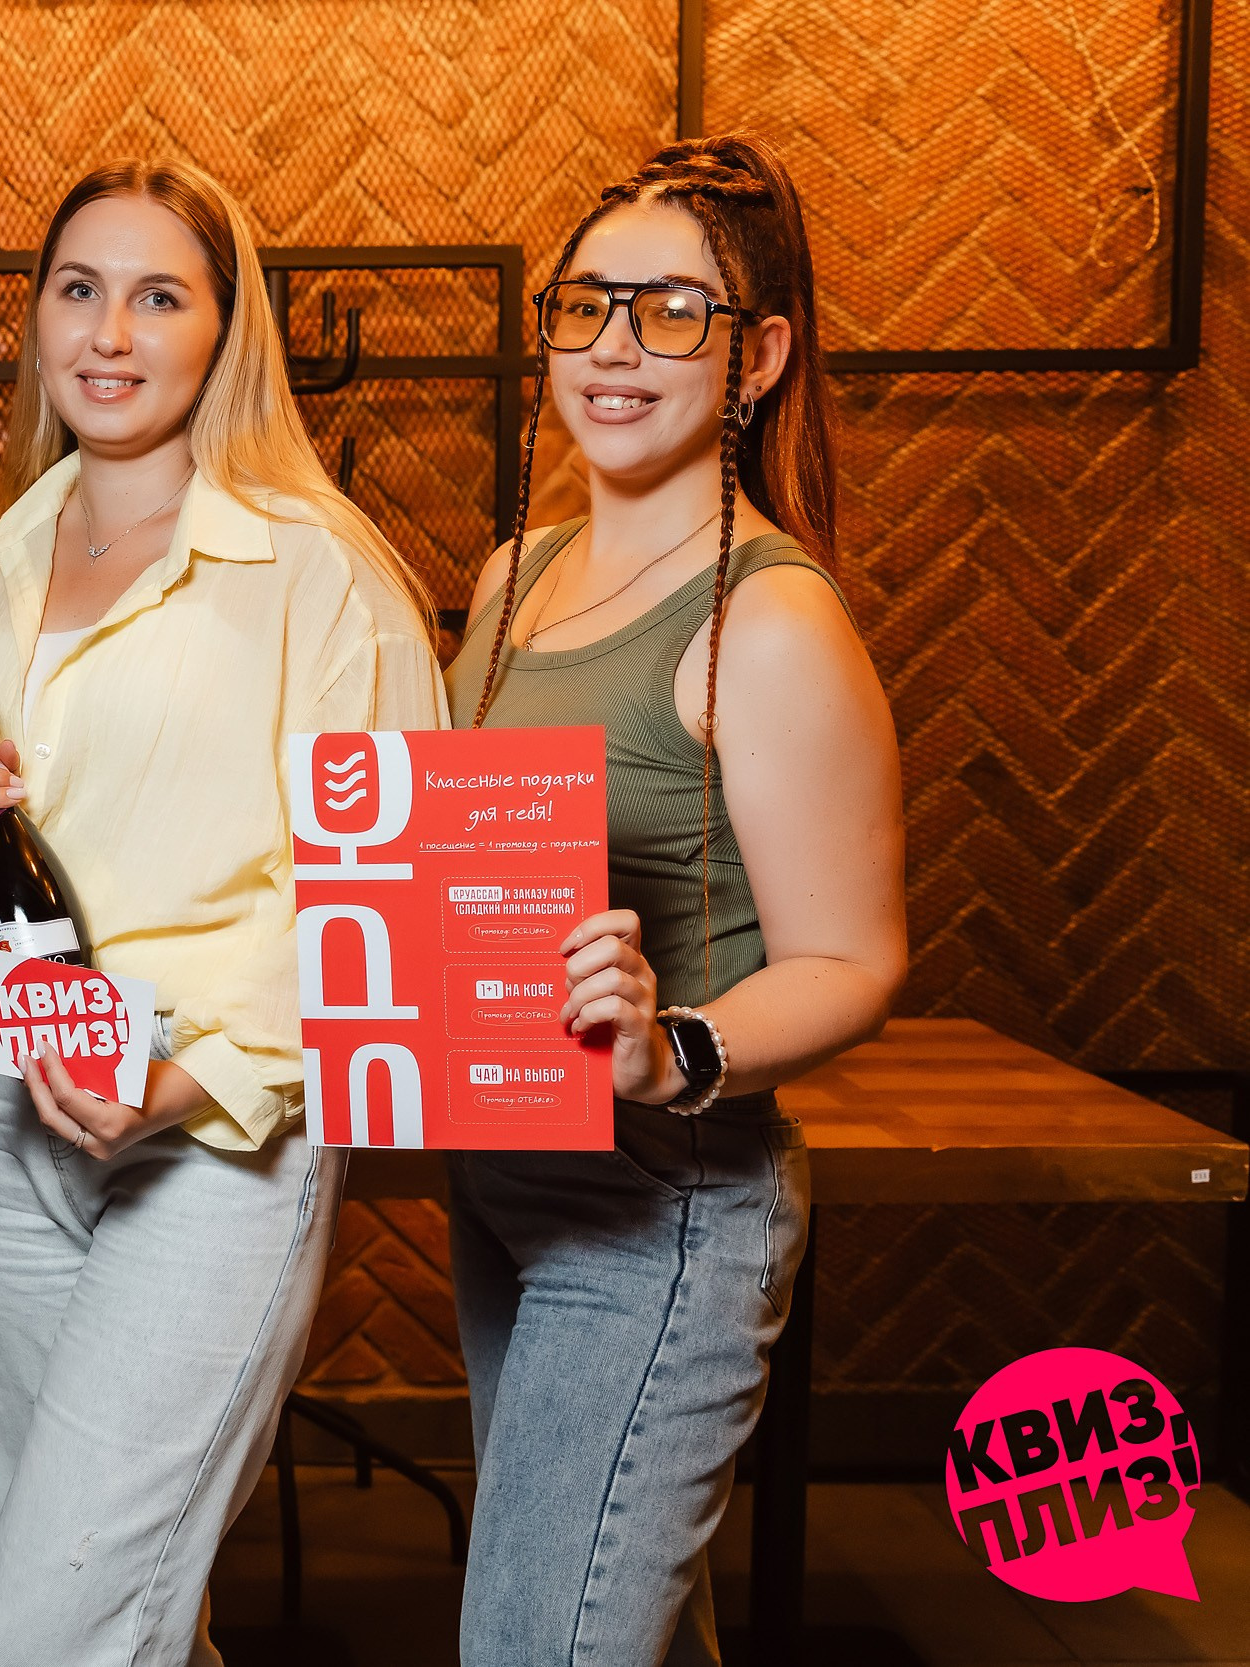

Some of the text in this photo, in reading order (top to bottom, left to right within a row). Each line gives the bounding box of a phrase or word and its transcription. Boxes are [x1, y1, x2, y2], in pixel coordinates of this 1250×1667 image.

[425, 770, 595, 797] Классные подарки
[464, 800, 553, 832] для тебя!
[419, 841, 423, 849] 1
[426, 842, 476, 850] посещение
[488, 841, 493, 849] 1
[495, 841, 537, 853] промокод
[550, 840, 600, 852] подарками
[453, 887, 575, 900] КРУАССАН К ЗАКАЗУ КОФЕ
[455, 902, 575, 915] (СЛАДКИЙ ИЛИ КЛАССИКА)
[480, 983, 554, 997] 1+1 НА КОФЕ
[0, 978, 126, 1020] КВИЗ,
[475, 1065, 565, 1082] ЧАЙ НА ВЫБОР
